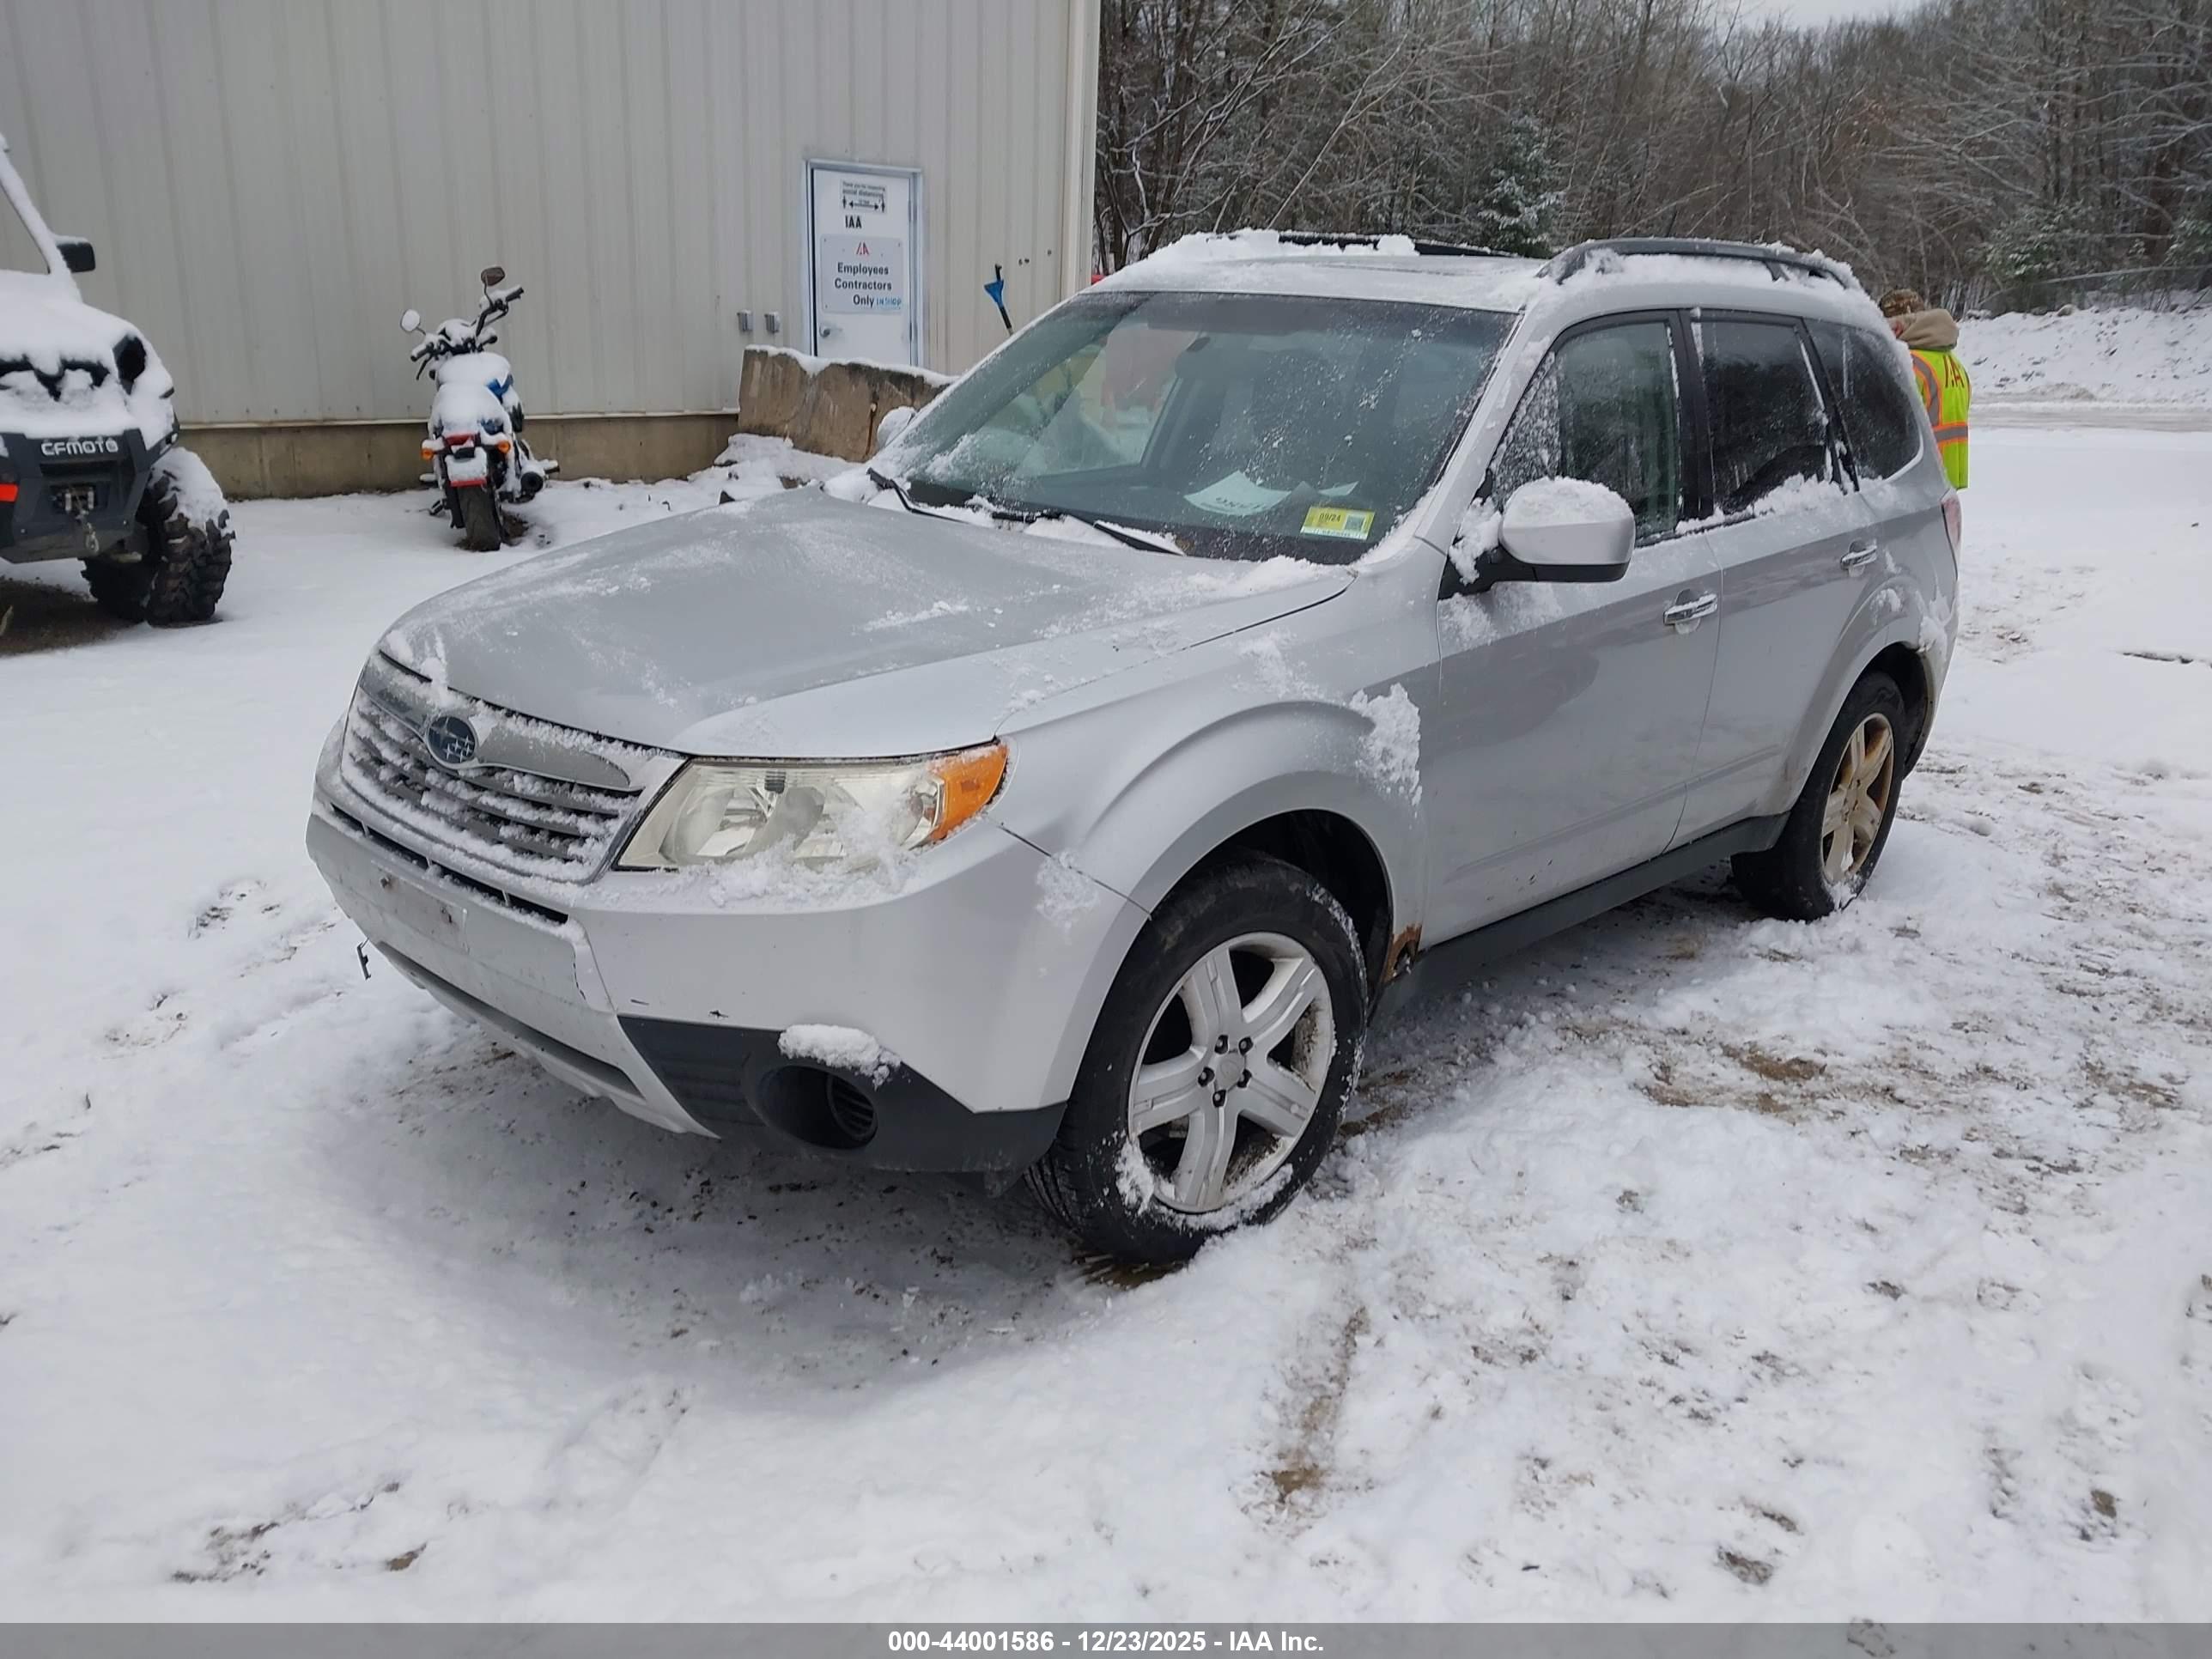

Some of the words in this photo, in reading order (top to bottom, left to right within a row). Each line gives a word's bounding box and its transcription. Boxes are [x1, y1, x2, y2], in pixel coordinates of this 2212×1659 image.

[845, 215, 862, 228] IAA
[837, 261, 889, 276] Employees
[835, 277, 892, 291] Contractors
[853, 294, 874, 308] Only
[41, 440, 118, 456] CFMOTO
